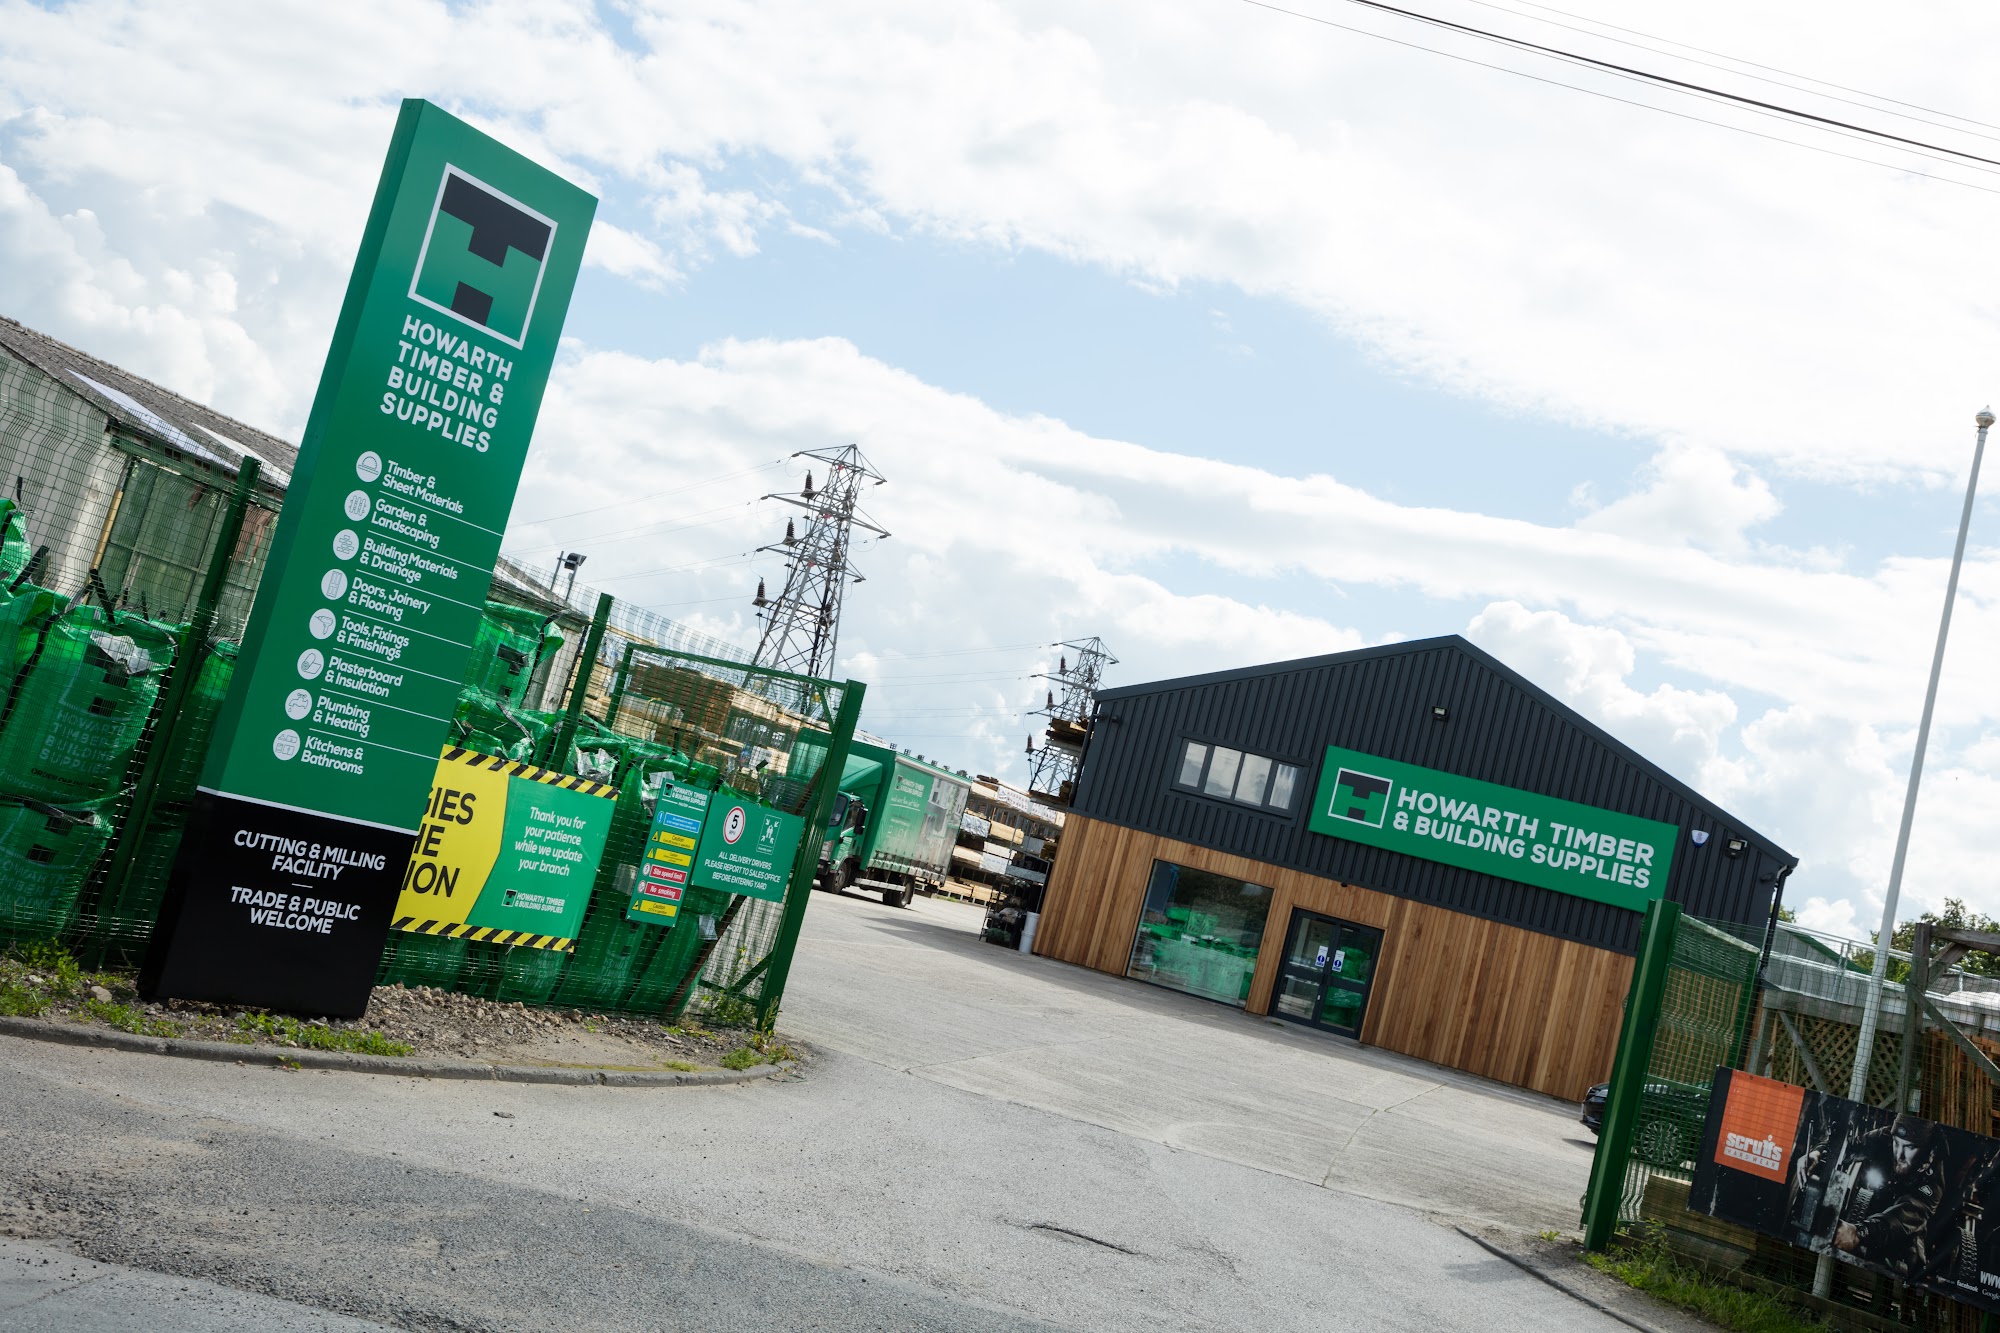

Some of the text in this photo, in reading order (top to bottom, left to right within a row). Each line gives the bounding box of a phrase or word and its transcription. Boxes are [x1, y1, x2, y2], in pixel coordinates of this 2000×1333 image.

[402, 315, 513, 381] HOWARTH
[398, 340, 504, 405] TIMBER &
[387, 366, 498, 428] BUILDING
[380, 392, 491, 452] SUPPLIES
[388, 460, 436, 489] Timber &
[382, 474, 463, 514] Sheet Materials
[376, 499, 427, 526] Garden &
[371, 512, 440, 549] Landscaping
[360, 552, 422, 583] & Drainage
[364, 538, 458, 579] Building Materials
[348, 591, 403, 621] & Flooring
[352, 577, 431, 614] Doors, Joinery
[337, 630, 401, 661] & Finishings
[342, 616, 409, 649] Tools, Fixings
[325, 670, 389, 698] & Insulation
[329, 656, 403, 687] Plasterboard
[317, 695, 370, 724] Plumbing
[313, 710, 370, 738] & Heating
[305, 736, 364, 760] Kitchens &
[301, 750, 364, 775] Bathrooms
[424, 787, 476, 825] IES
[530, 806, 586, 830] Thank you for
[524, 825, 581, 846] your patience
[732, 814, 739, 829] 5
[1397, 787, 1655, 867] HOWARTH TIMBER
[234, 830, 386, 871] CUTTING & MILLING
[515, 838, 583, 863] while we update
[718, 851, 772, 870] ALL DELIVERY DRIVERS
[1393, 811, 1650, 889] & BUILDING SUPPLIES
[272, 855, 344, 880] FACILITY
[518, 857, 570, 876] your branch
[661, 871, 673, 879] speed
[704, 859, 781, 883] PLEASE REPORT TO SALES OFFICE
[650, 885, 675, 899] No smoking
[712, 872, 767, 890] BEFORE ENTERING YARD
[230, 886, 361, 921] TRADE & PUBLIC
[517, 892, 565, 907] HOWARTH TIMBER
[519, 900, 541, 910] BUILDING
[541, 904, 563, 914] SUPPLIES
[250, 907, 334, 934] WELCOME
[1727, 1149, 1776, 1168] HARDWEAR
[1956, 1279, 1978, 1292] facebook
